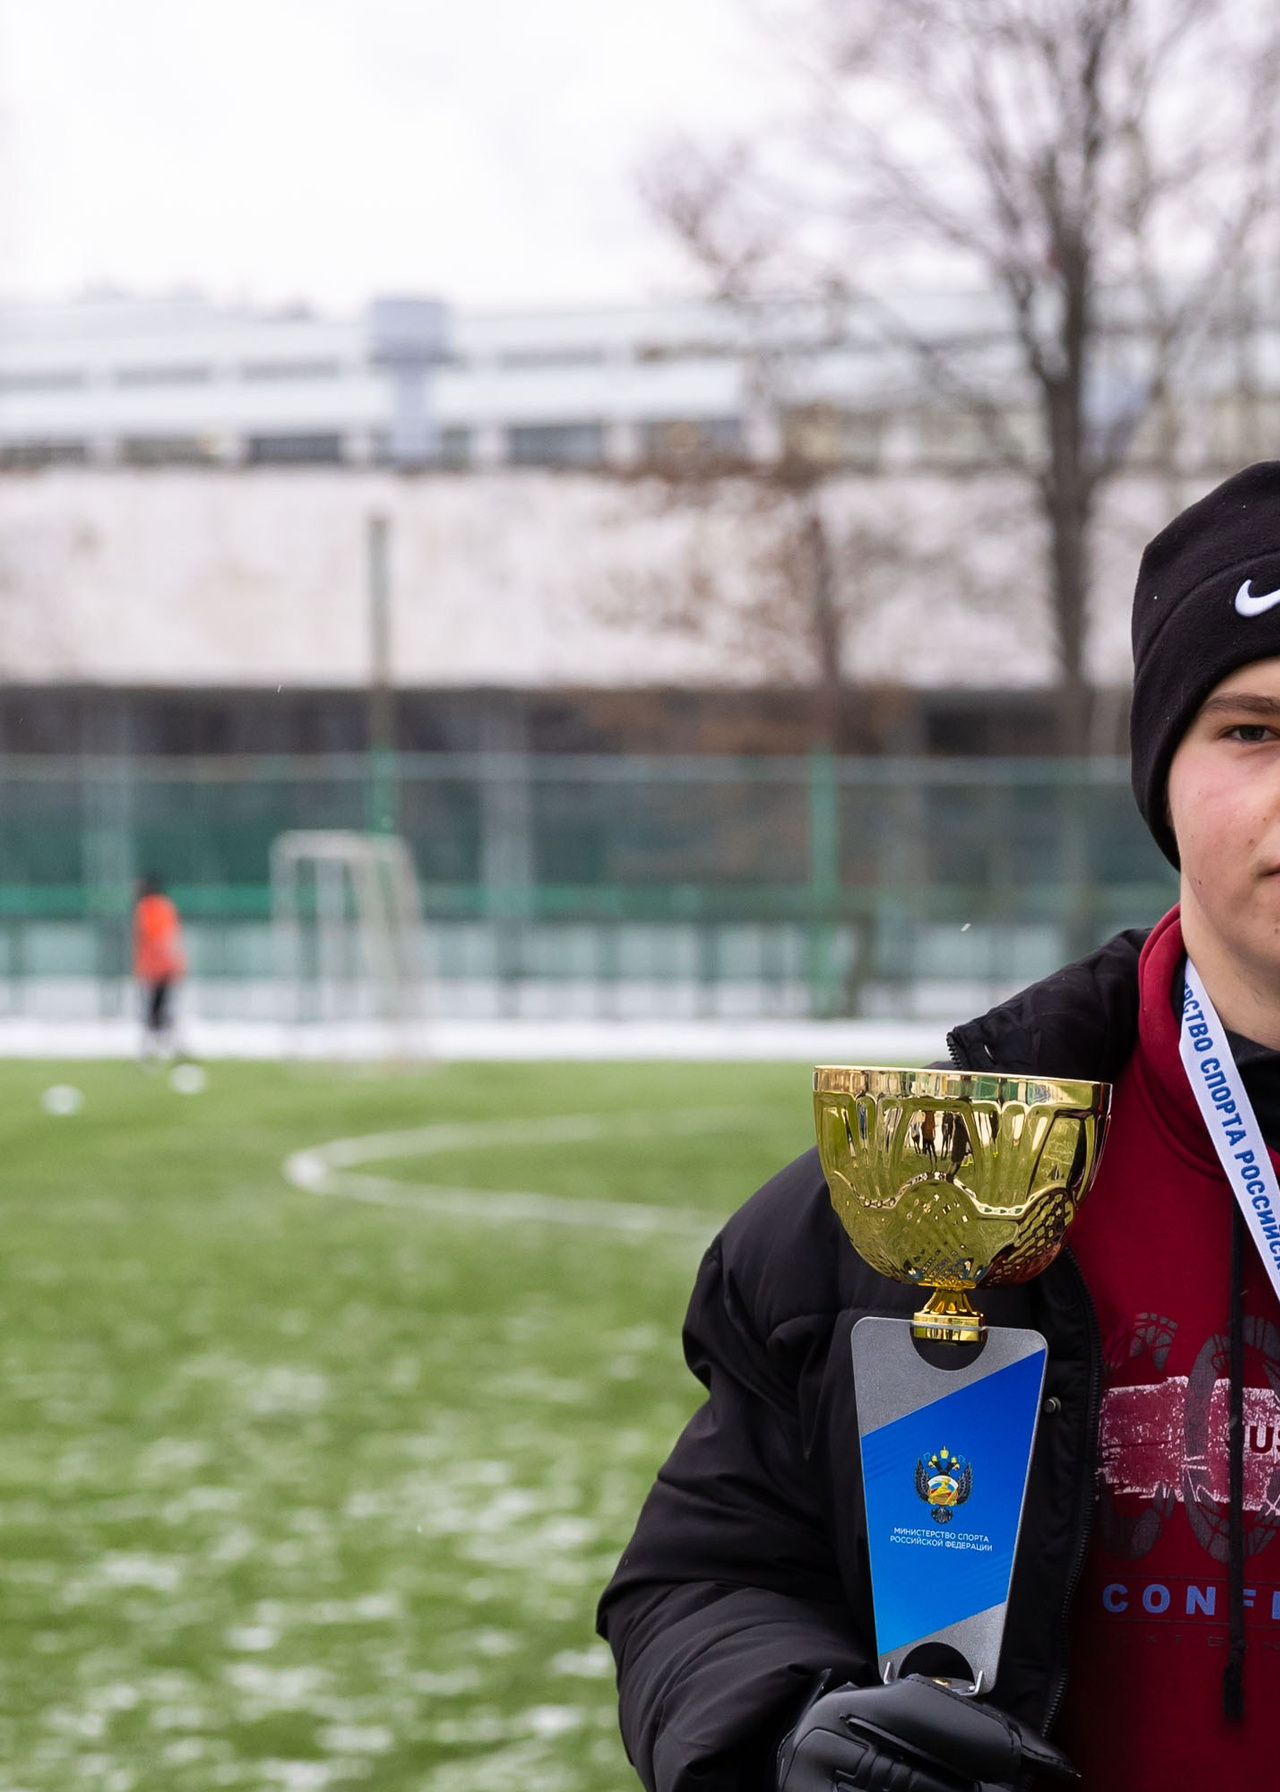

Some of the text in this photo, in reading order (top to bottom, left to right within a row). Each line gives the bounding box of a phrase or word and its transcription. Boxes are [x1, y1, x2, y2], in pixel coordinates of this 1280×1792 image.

[1201, 1058, 1246, 1148] СПОРТА
[894, 1527, 989, 1543] МИНИСТЕРСТВО СПОРТА
[890, 1536, 993, 1552] РОССИЙСКОЙ ФЕДЕРАЦИИ
